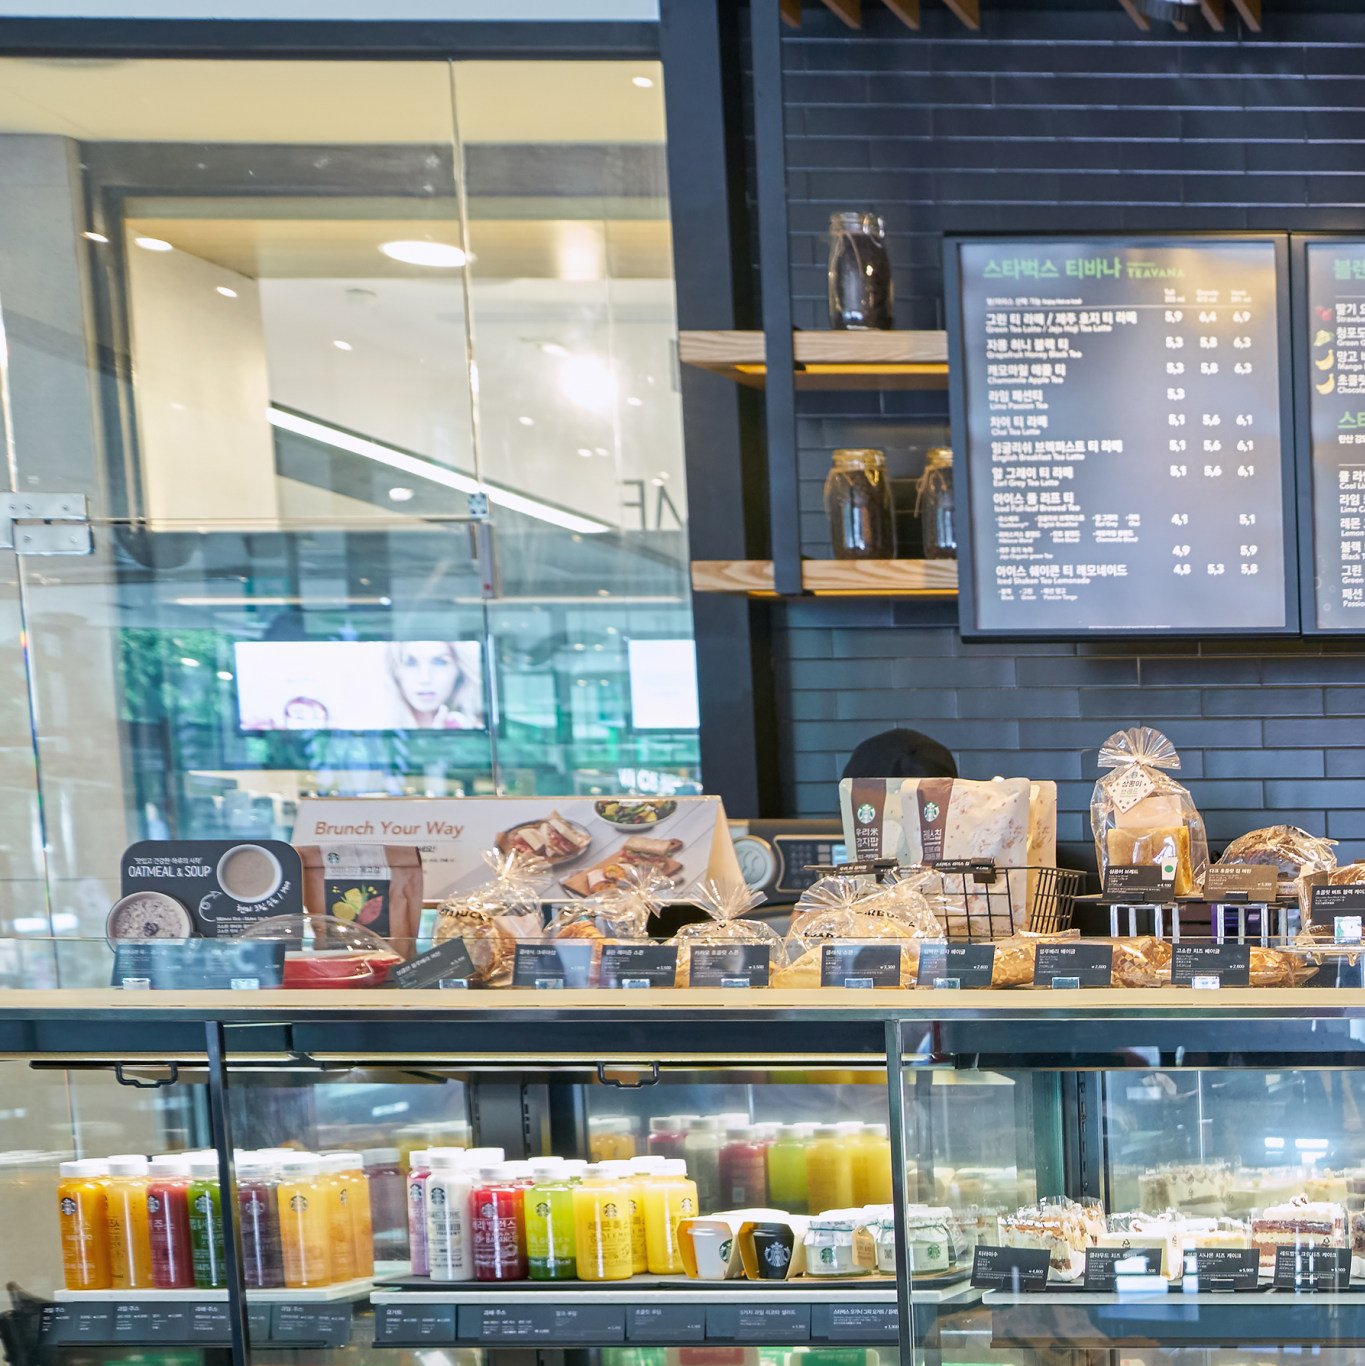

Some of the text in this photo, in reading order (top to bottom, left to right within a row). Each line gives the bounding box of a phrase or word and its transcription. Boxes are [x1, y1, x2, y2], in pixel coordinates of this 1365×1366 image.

[983, 259, 1059, 280] 스타벅스
[1066, 259, 1120, 279] 티바나
[314, 820, 464, 843] Brunch Your Way
[129, 866, 211, 878] OATMEAL & SOUP
